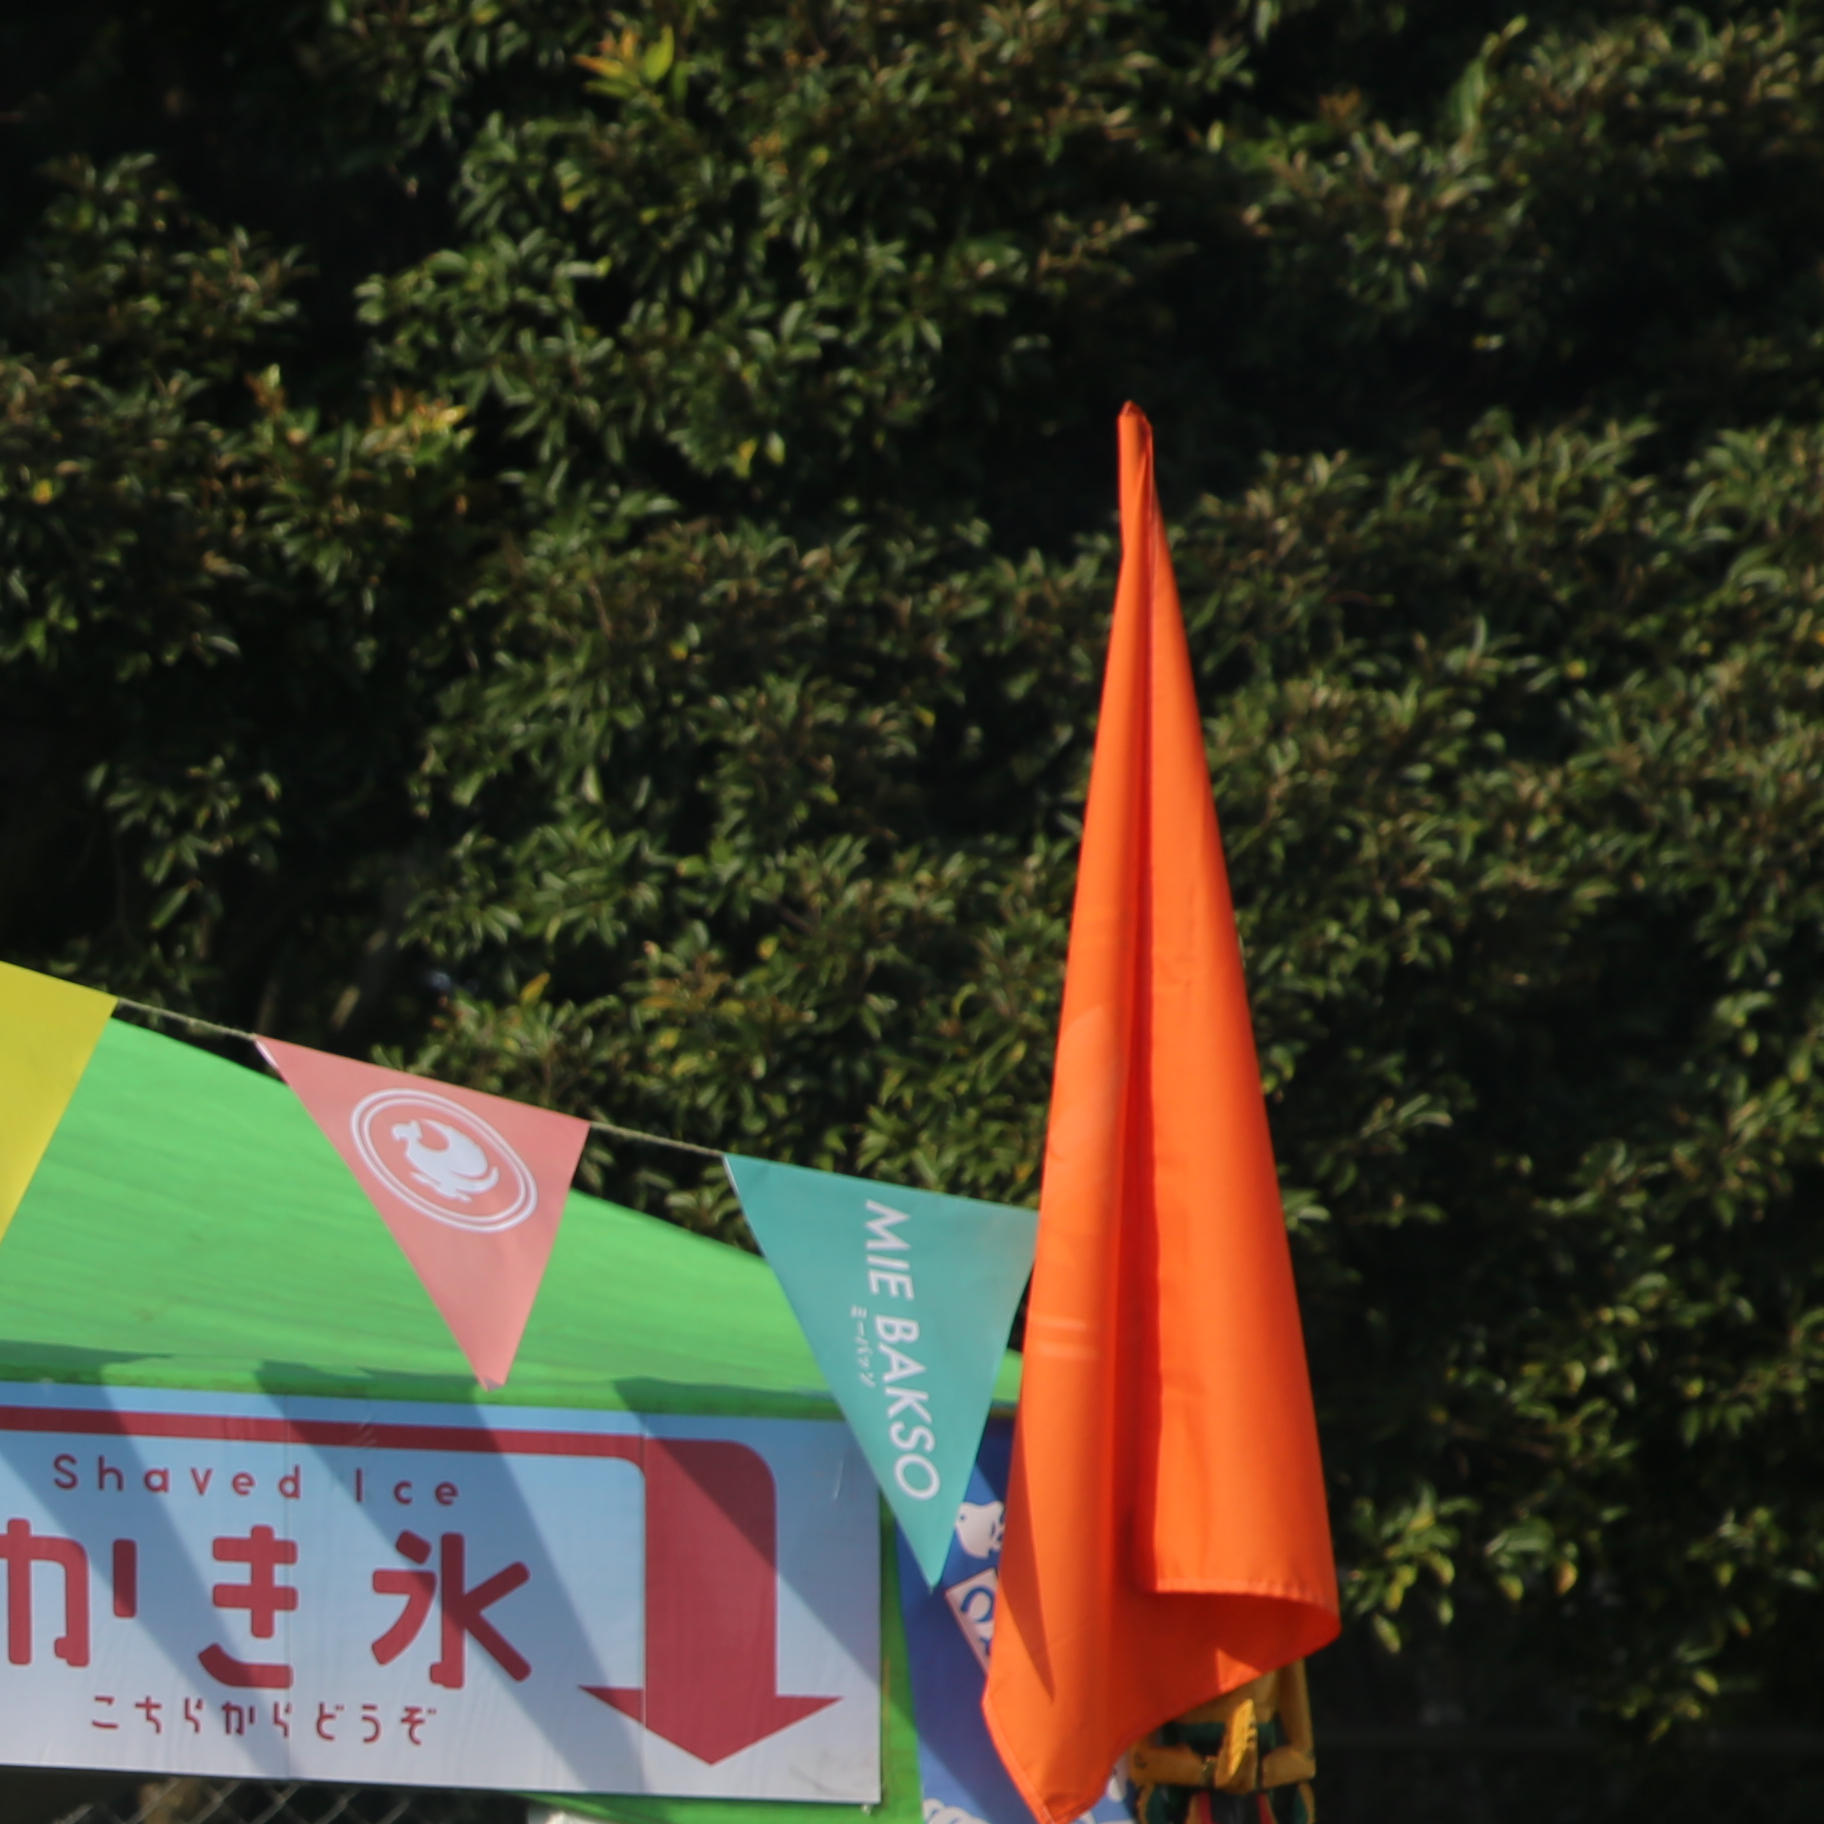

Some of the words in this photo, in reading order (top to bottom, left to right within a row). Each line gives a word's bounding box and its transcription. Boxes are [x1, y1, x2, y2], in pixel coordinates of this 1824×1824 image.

[865, 1198, 916, 1302] MIE
[873, 1316, 941, 1503] BAKSO
[51, 1452, 305, 1502] Shaved
[354, 1469, 460, 1507] Ice
[91, 1693, 439, 1748] こちらからどうぞ
